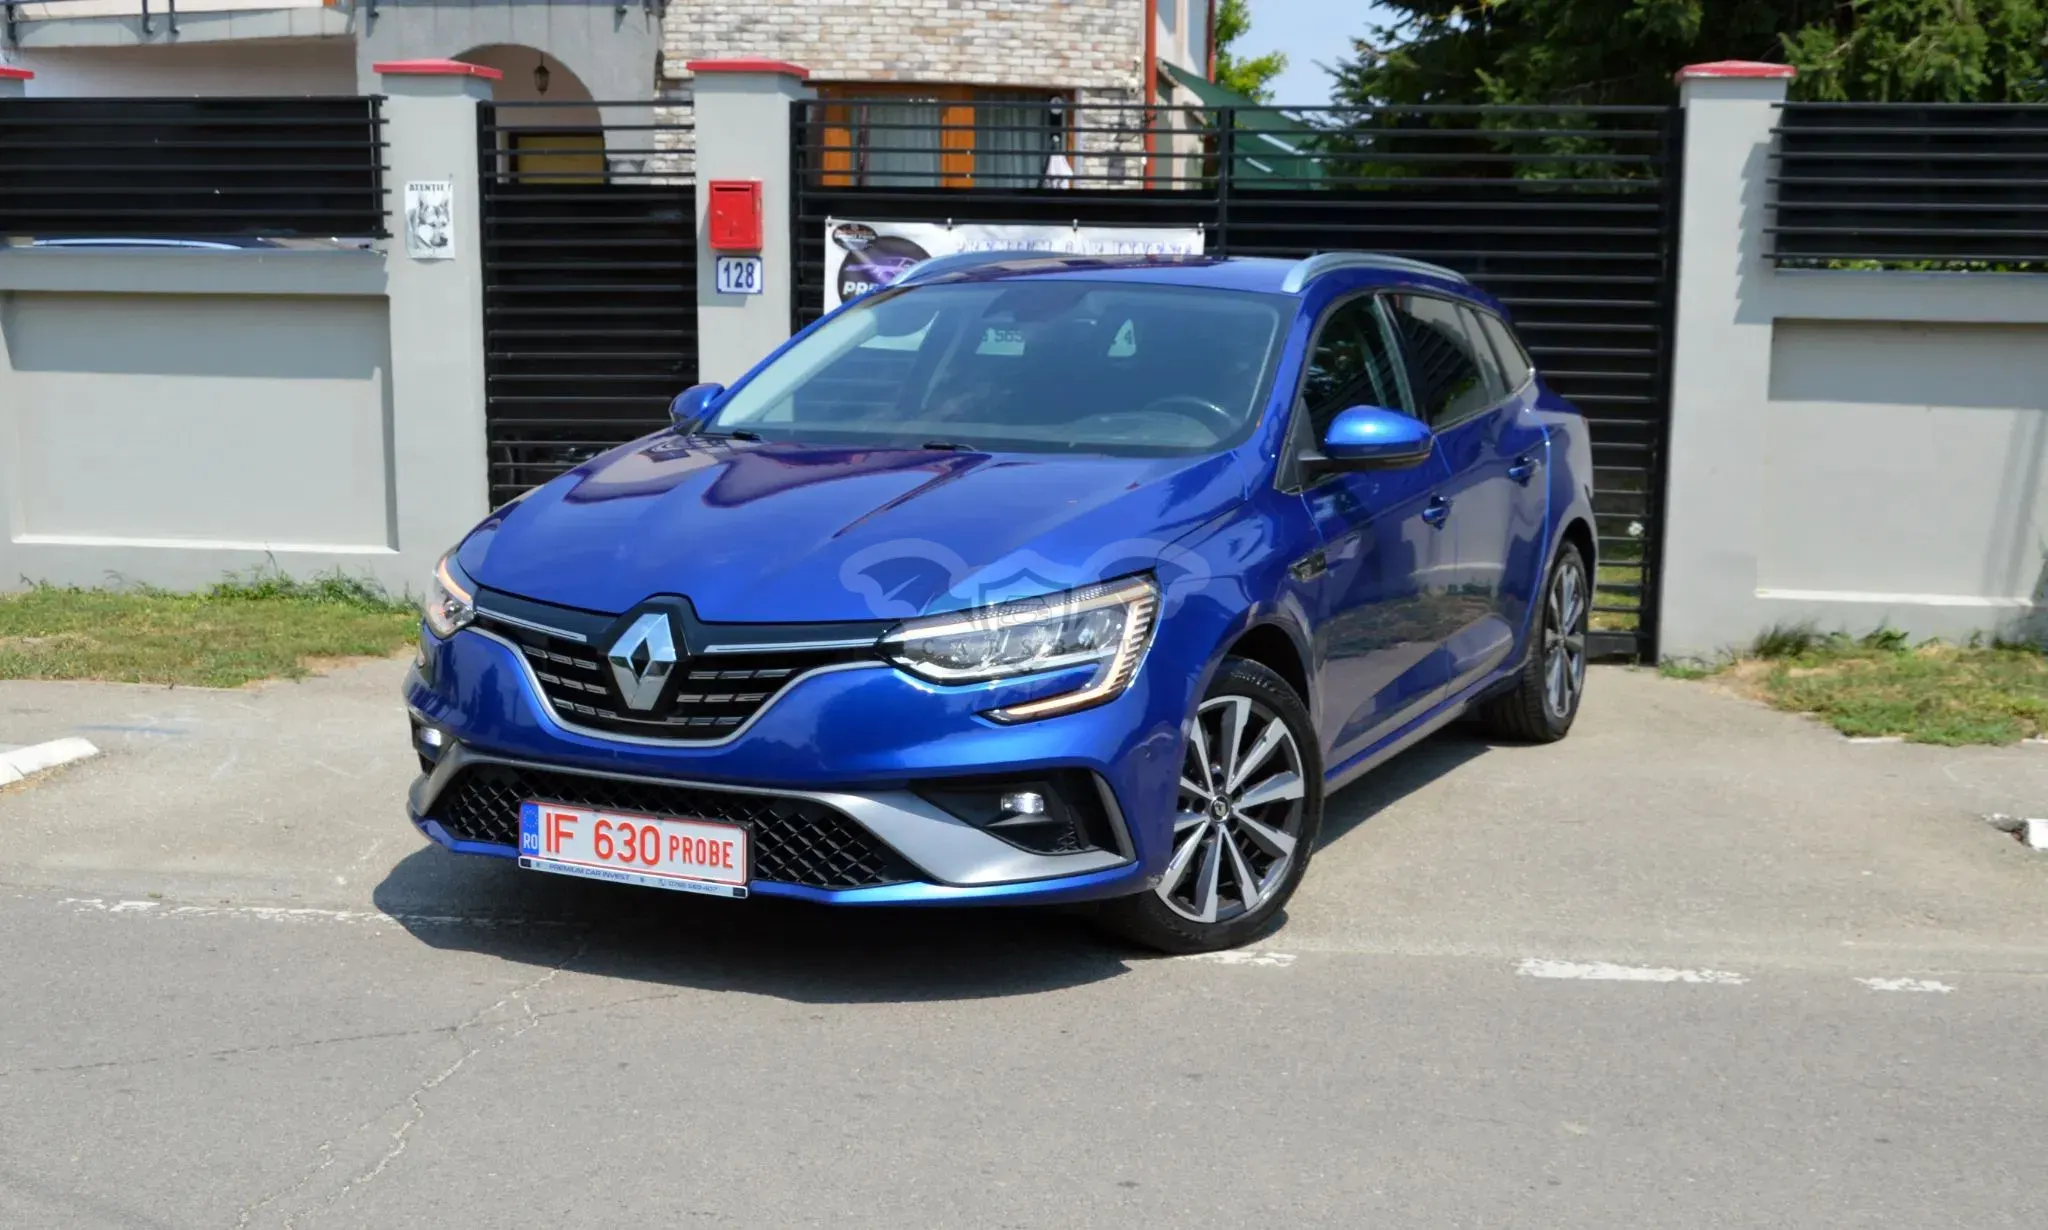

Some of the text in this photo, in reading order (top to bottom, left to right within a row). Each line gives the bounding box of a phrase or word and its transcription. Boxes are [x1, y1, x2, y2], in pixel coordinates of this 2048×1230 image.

[723, 261, 755, 288] 128
[523, 832, 538, 850] RO
[545, 812, 734, 869] IF 630 PROBE
[549, 863, 584, 874] PREMIUM
[586, 867, 602, 877] CAR
